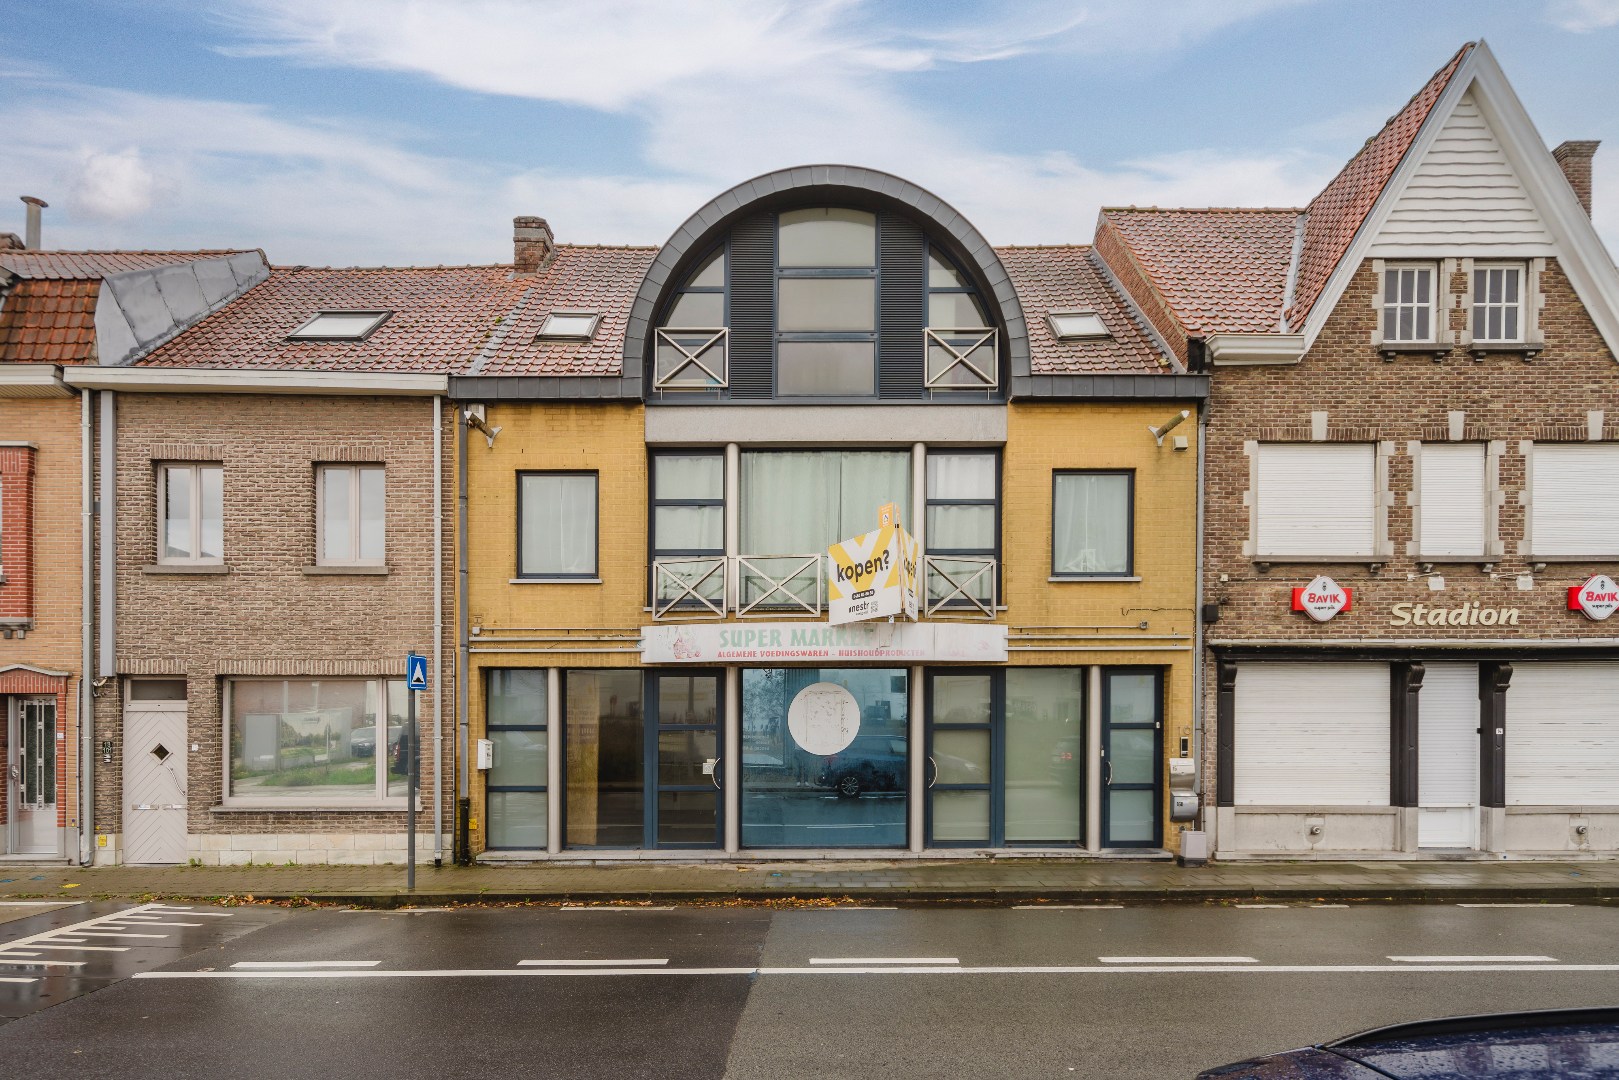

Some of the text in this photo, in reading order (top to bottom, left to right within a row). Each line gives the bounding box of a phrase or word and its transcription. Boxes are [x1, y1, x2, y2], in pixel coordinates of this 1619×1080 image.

[836, 549, 890, 583] kopen?
[1307, 592, 1341, 603] BAVIK
[1585, 591, 1619, 602] BAVIK
[1389, 600, 1520, 626] Stadion
[719, 627, 875, 648] SUPER MARKET
[717, 650, 757, 658] ALGEMENE
[760, 649, 829, 658] VOEDINGSWAREN
[838, 649, 925, 657] HUISHOUDPRODUCTEN
